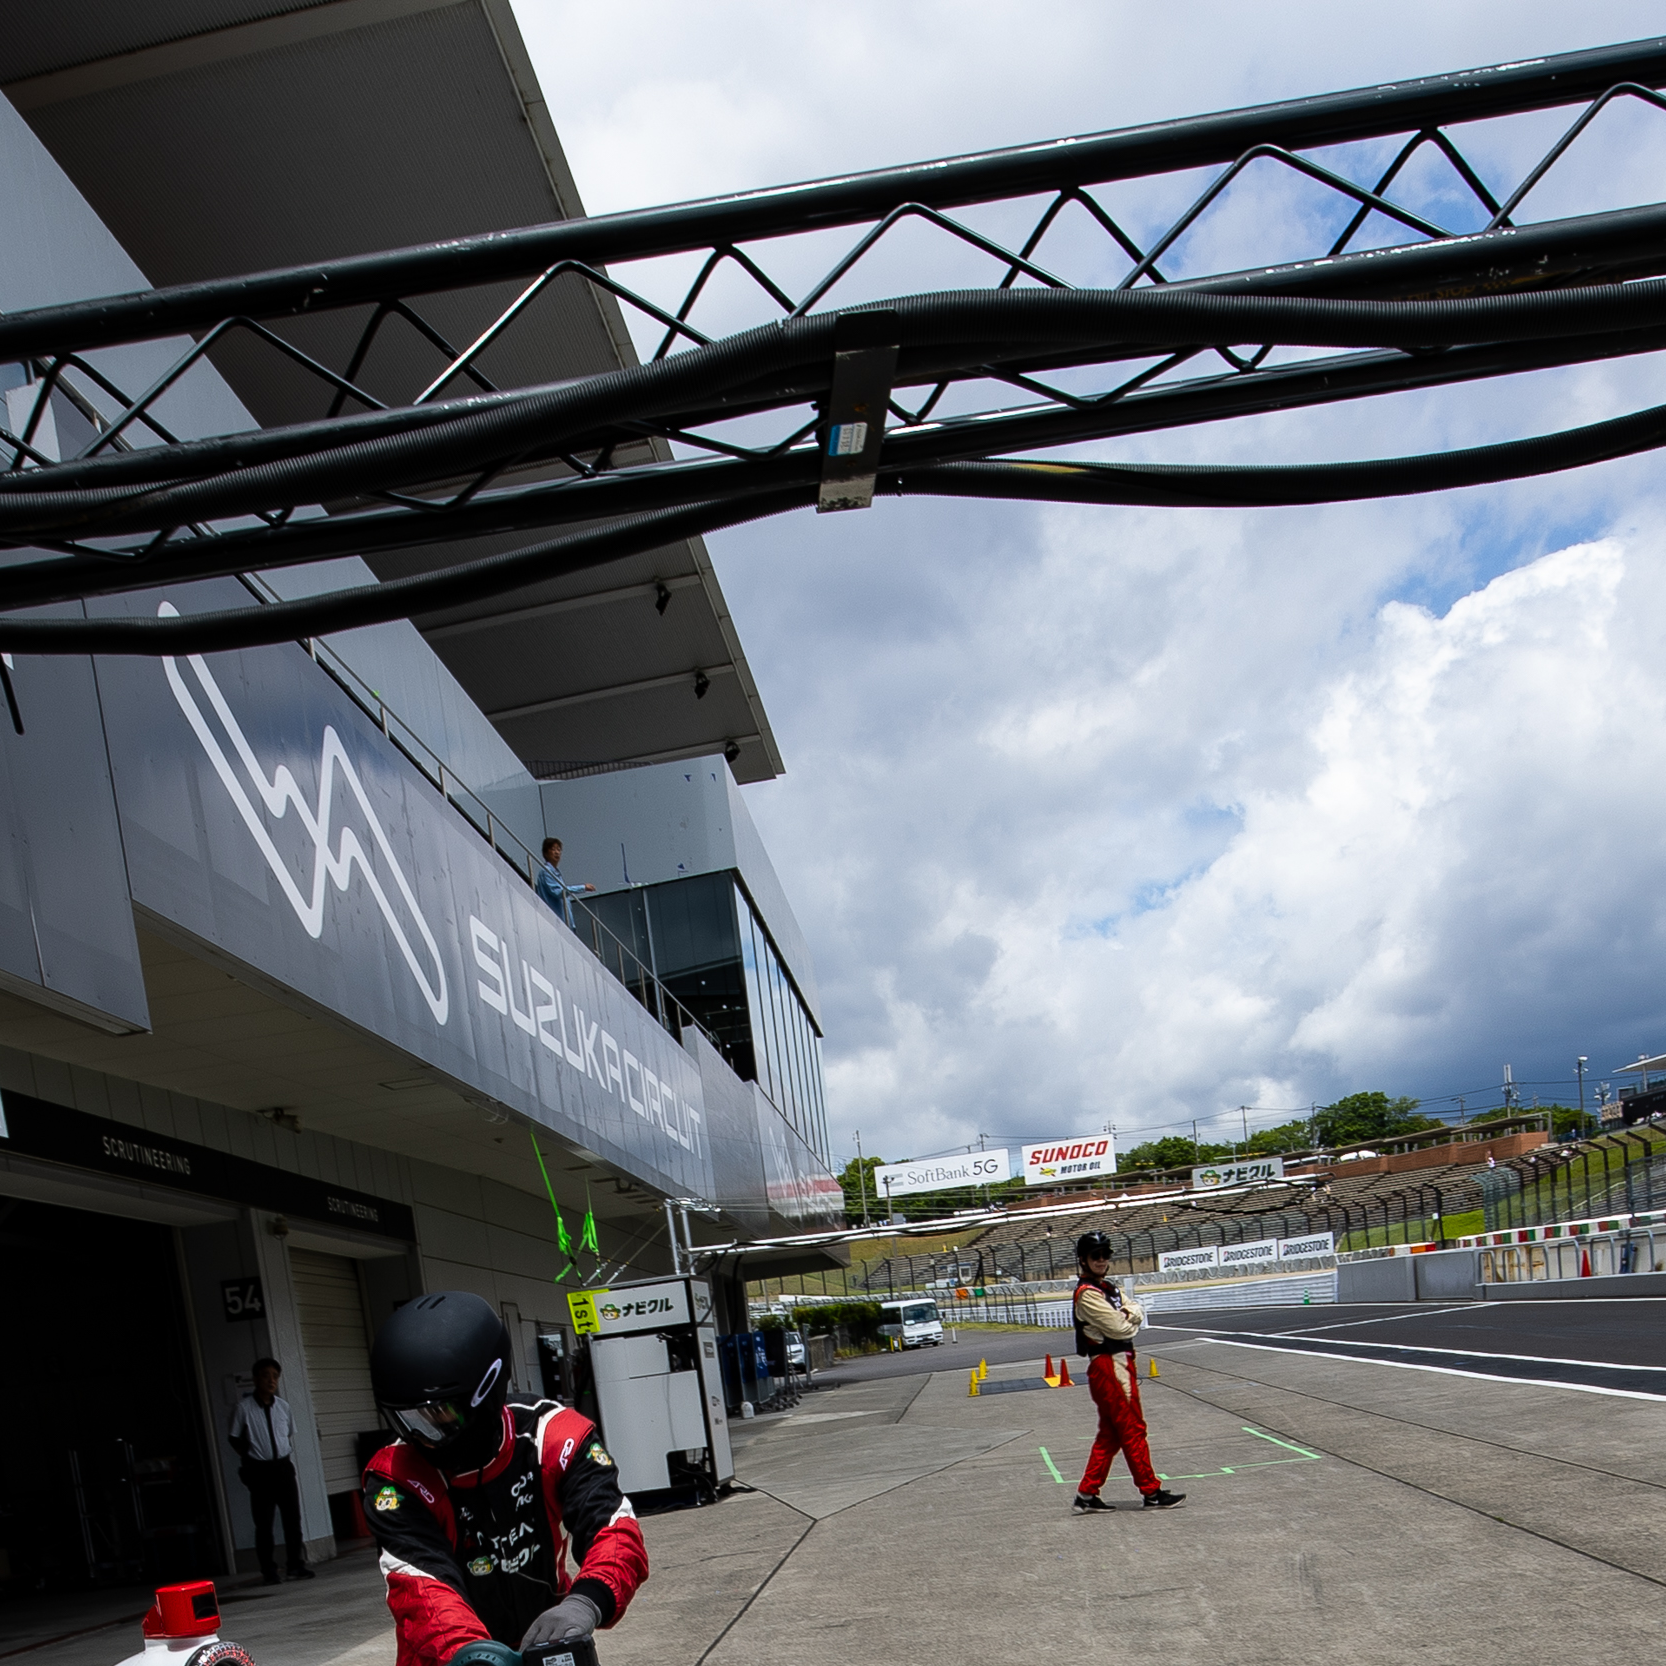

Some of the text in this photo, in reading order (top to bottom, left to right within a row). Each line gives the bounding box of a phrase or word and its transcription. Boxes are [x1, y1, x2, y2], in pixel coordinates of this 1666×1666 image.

[470, 914, 702, 1160] SUZUKA CIRCUIT
[102, 1136, 191, 1175] SCRUTINEERING
[1029, 1140, 1108, 1165] SUNOCO
[907, 1159, 998, 1186] SoftBank 5G
[1060, 1161, 1101, 1174] MOTOR OIL
[327, 1196, 379, 1222] SCRUTINEERING
[1164, 1252, 1213, 1268] BRIDGESTONE
[1223, 1245, 1273, 1262] BRIDGESTONE
[1283, 1239, 1330, 1256] BRIDGESTONE
[225, 1284, 262, 1315] 54
[622, 1297, 674, 1317] ナビクル
